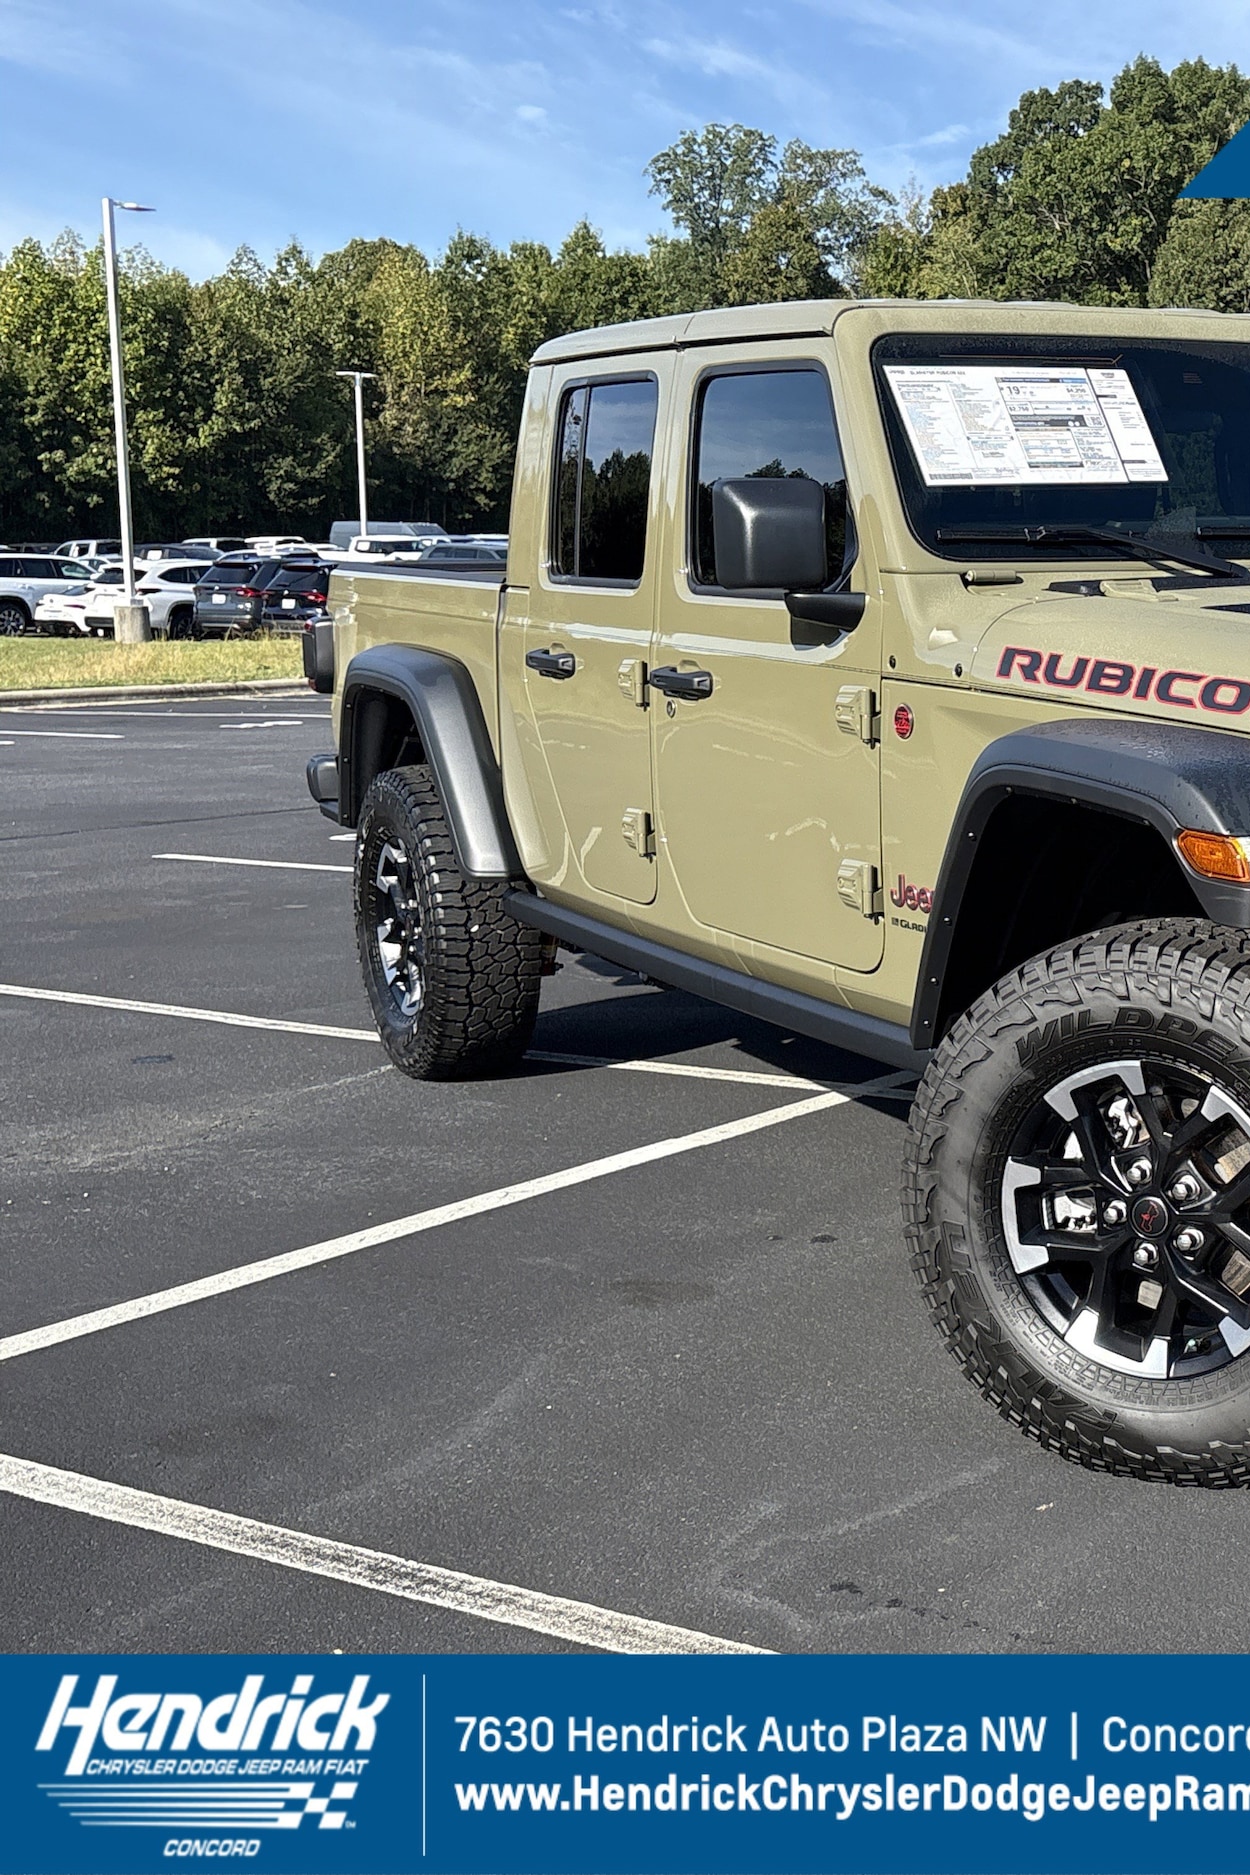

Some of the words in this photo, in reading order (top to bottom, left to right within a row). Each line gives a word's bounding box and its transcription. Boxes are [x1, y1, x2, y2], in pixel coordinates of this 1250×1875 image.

[1006, 385, 1021, 396] 19
[889, 873, 936, 914] Jee
[900, 919, 928, 933] GLADI
[943, 1220, 1126, 1433] FALKEN
